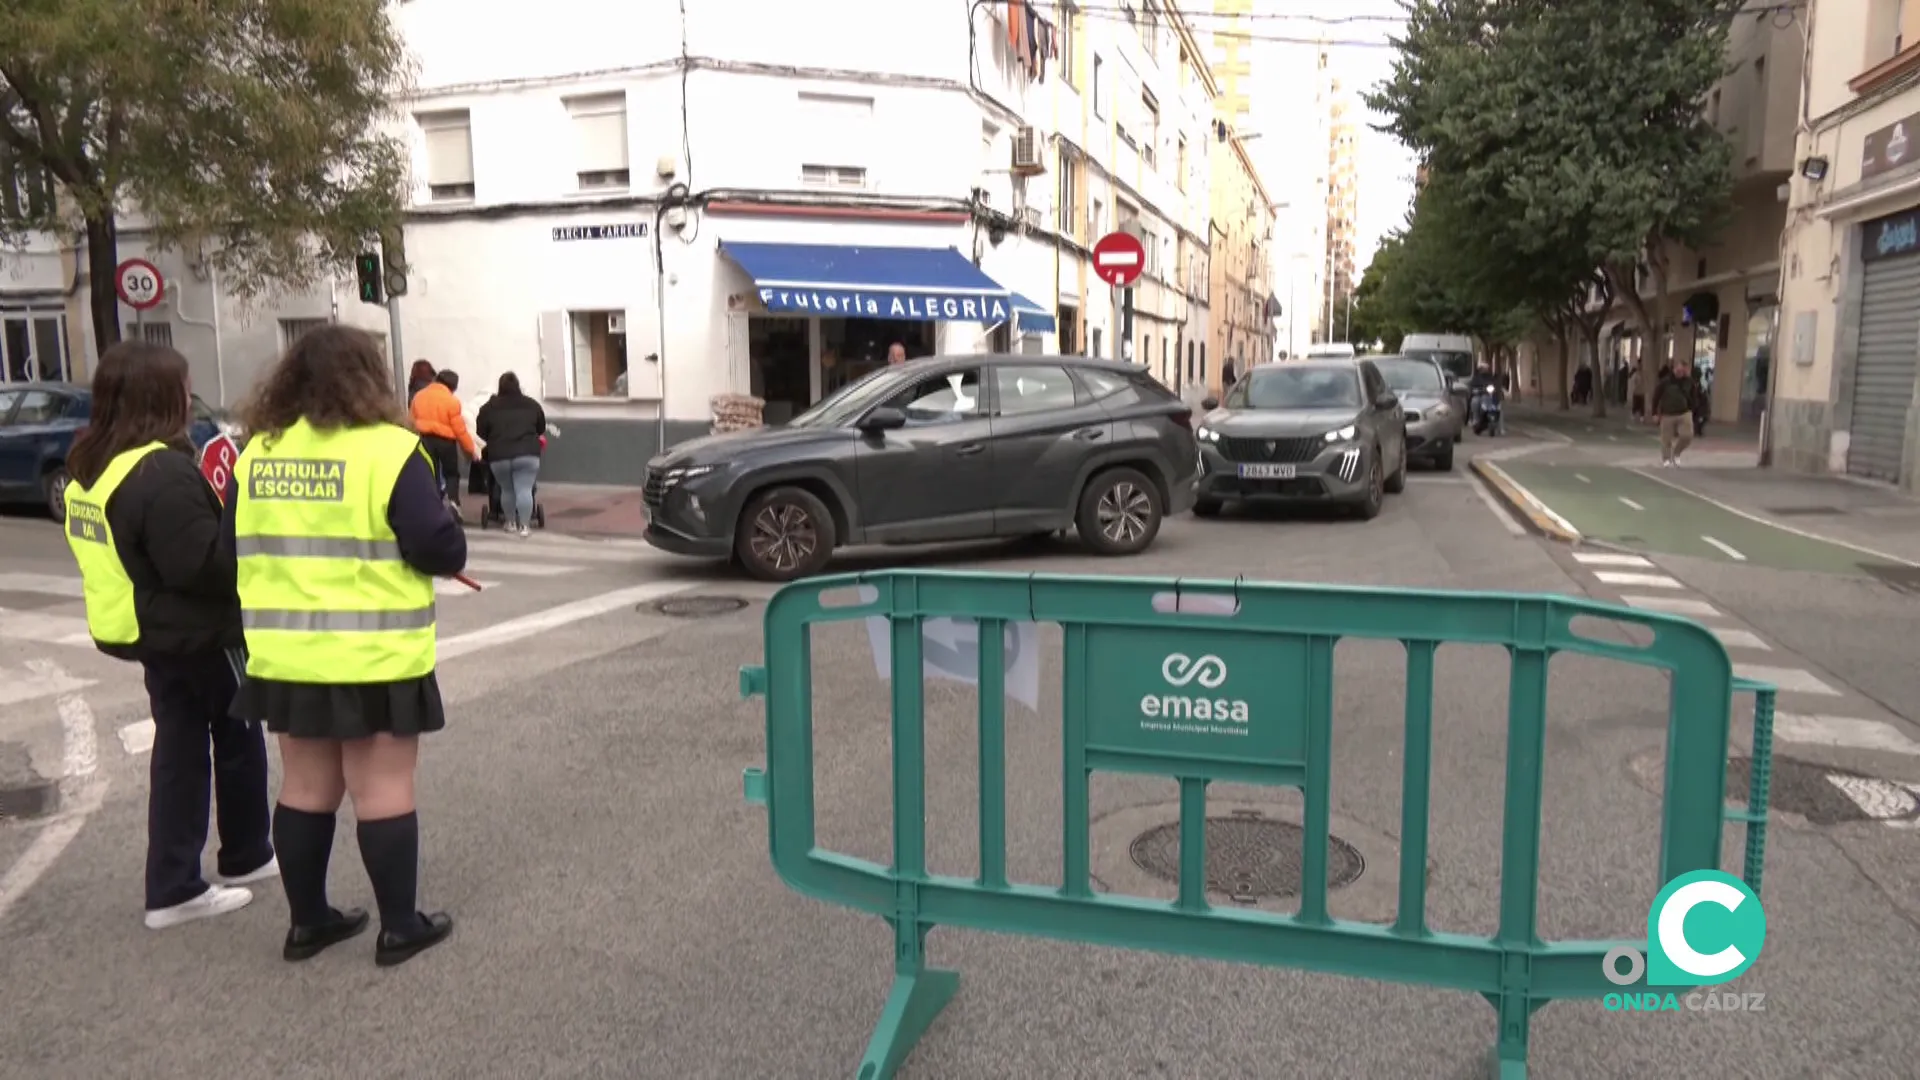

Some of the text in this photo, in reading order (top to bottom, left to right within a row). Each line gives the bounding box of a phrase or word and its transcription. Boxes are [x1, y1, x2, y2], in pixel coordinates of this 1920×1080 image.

[127, 274, 153, 292] 30
[890, 296, 1006, 318] ALEGRÍA
[213, 445, 231, 491] OP
[252, 462, 341, 480] PATRULLA
[254, 479, 338, 498] ESCOLAR
[1140, 693, 1249, 723] emasa
[1140, 720, 1171, 731] Empresa
[1173, 721, 1209, 734] Municipal
